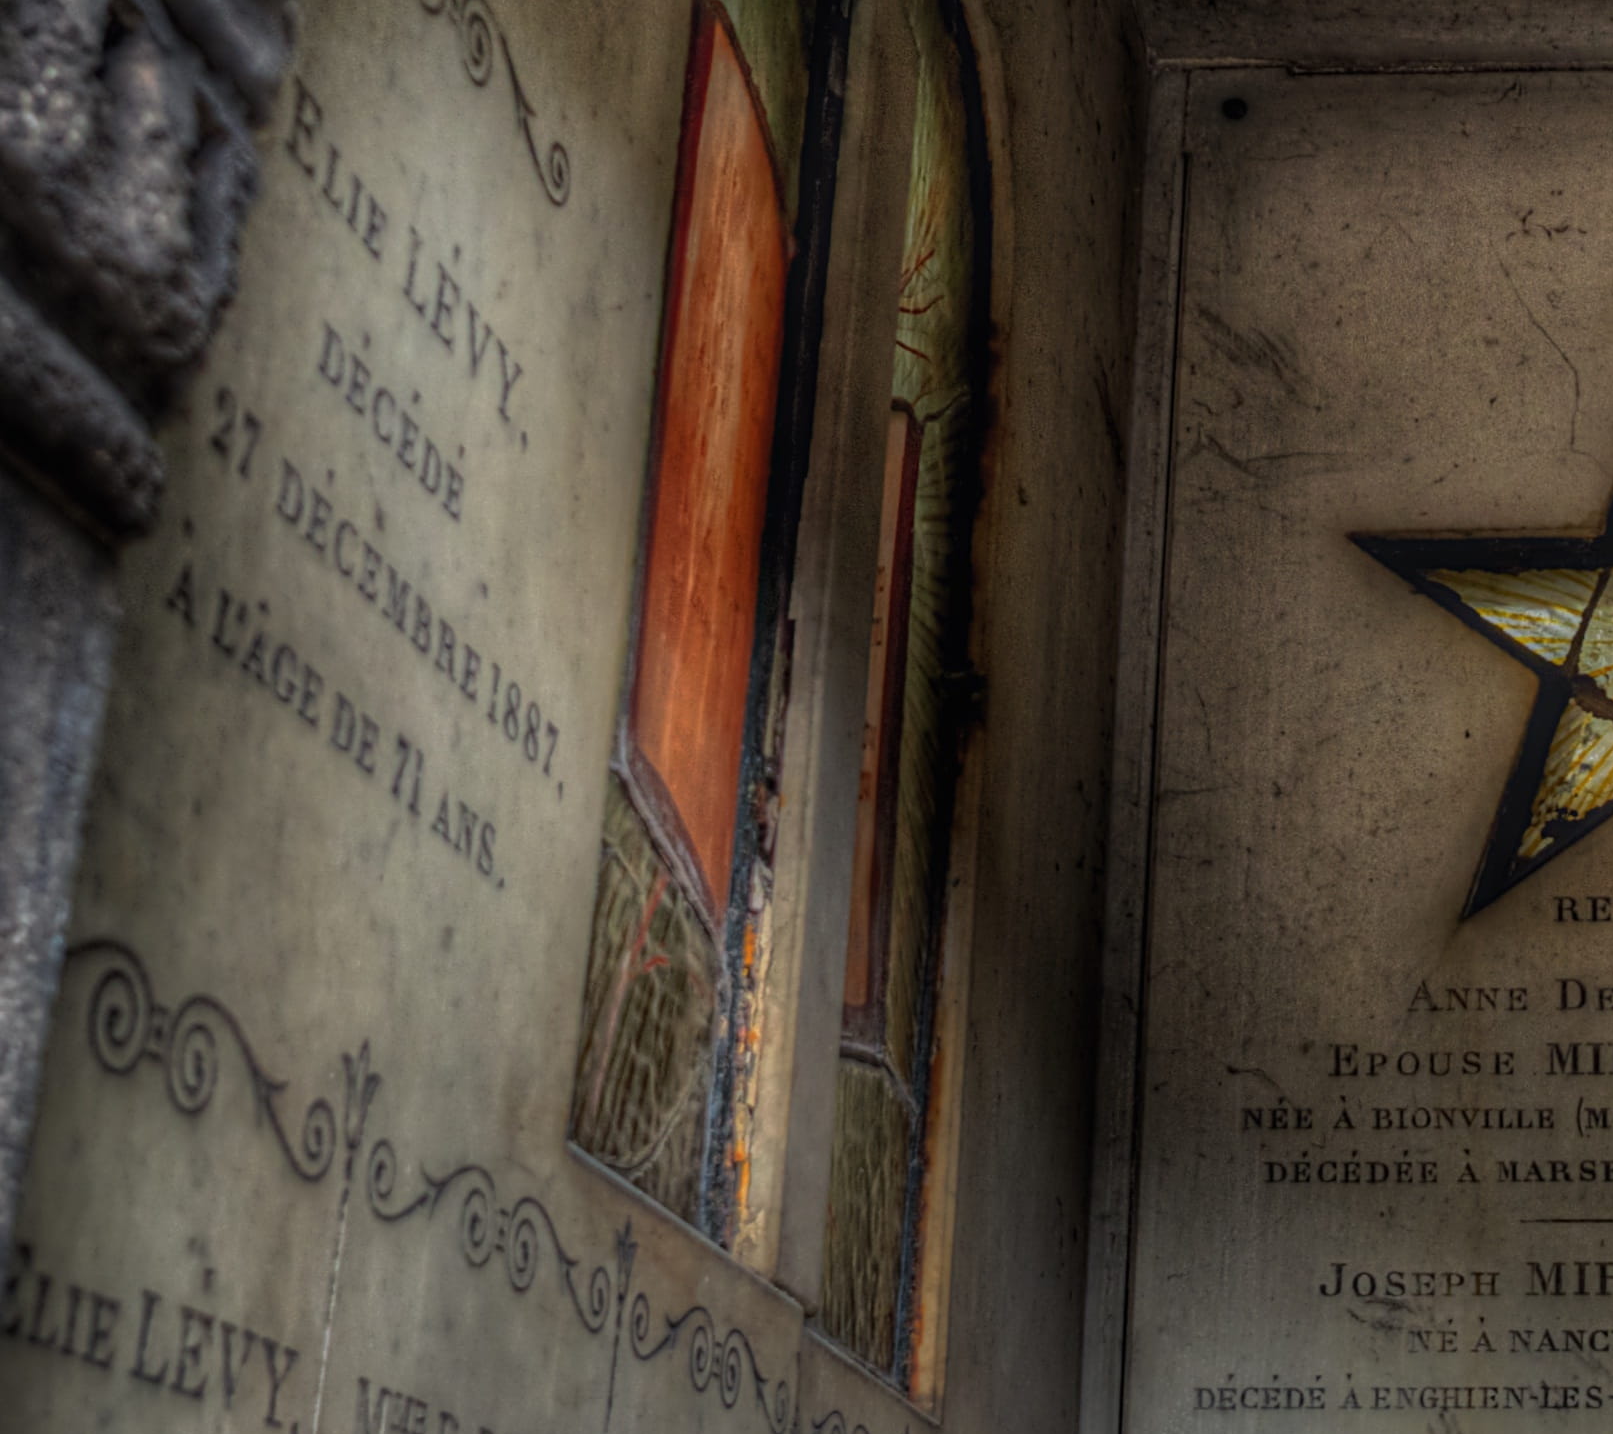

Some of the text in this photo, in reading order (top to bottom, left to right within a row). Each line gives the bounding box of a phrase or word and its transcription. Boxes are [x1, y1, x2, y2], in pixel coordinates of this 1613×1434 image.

[210, 384, 263, 483] 27
[316, 320, 467, 523] DÉCÉDÉ
[331, 692, 382, 777] DE
[1407, 977, 1532, 1015] ANNE
[1240, 1096, 1314, 1133] NÉE
[1372, 1103, 1557, 1133] BIONVILLE
[1264, 1148, 1441, 1187] DÉCÉDÉE
[1317, 1260, 1502, 1301] JOSEPH
[1407, 1316, 1460, 1356] NÉ
[1194, 1372, 1328, 1412] DÉCÉDÉ
